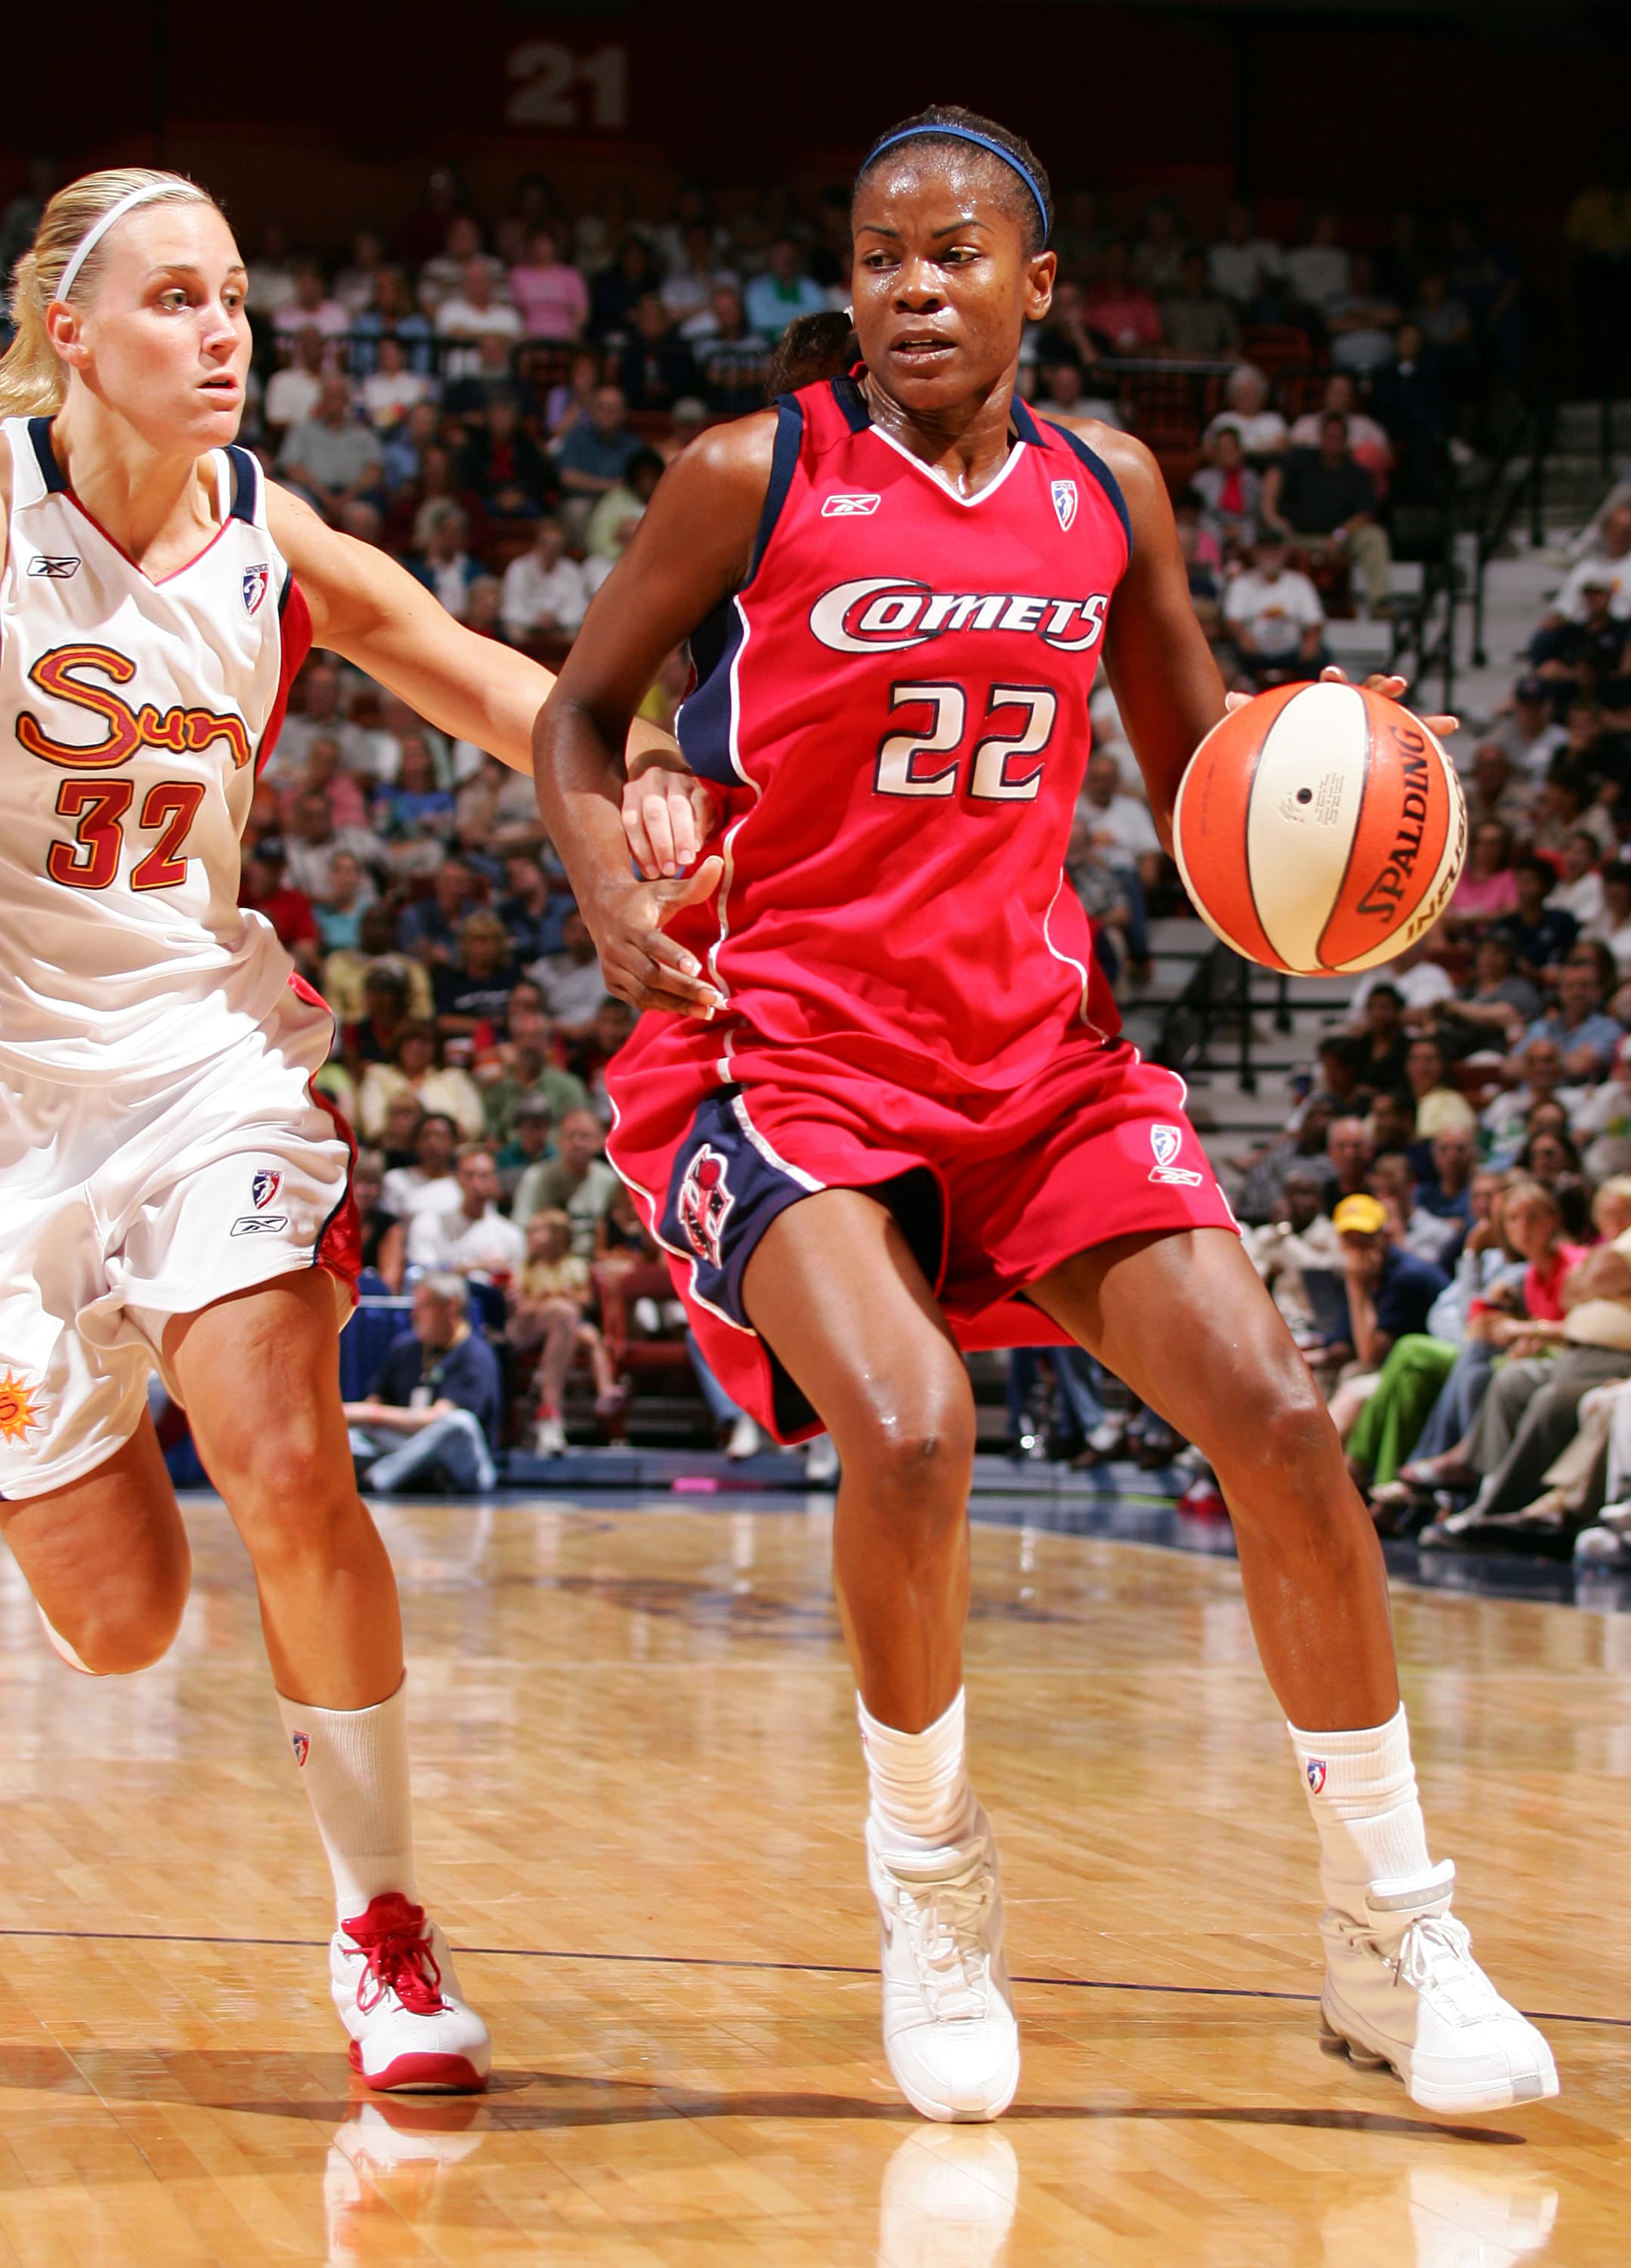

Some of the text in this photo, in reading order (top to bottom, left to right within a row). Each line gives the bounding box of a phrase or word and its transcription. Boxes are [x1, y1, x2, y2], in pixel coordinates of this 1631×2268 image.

[505, 42, 629, 129] 21
[16, 643, 252, 770] Sun
[873, 680, 1057, 803] 22
[47, 779, 206, 891] 32
[1357, 724, 1429, 923] SPALDING
